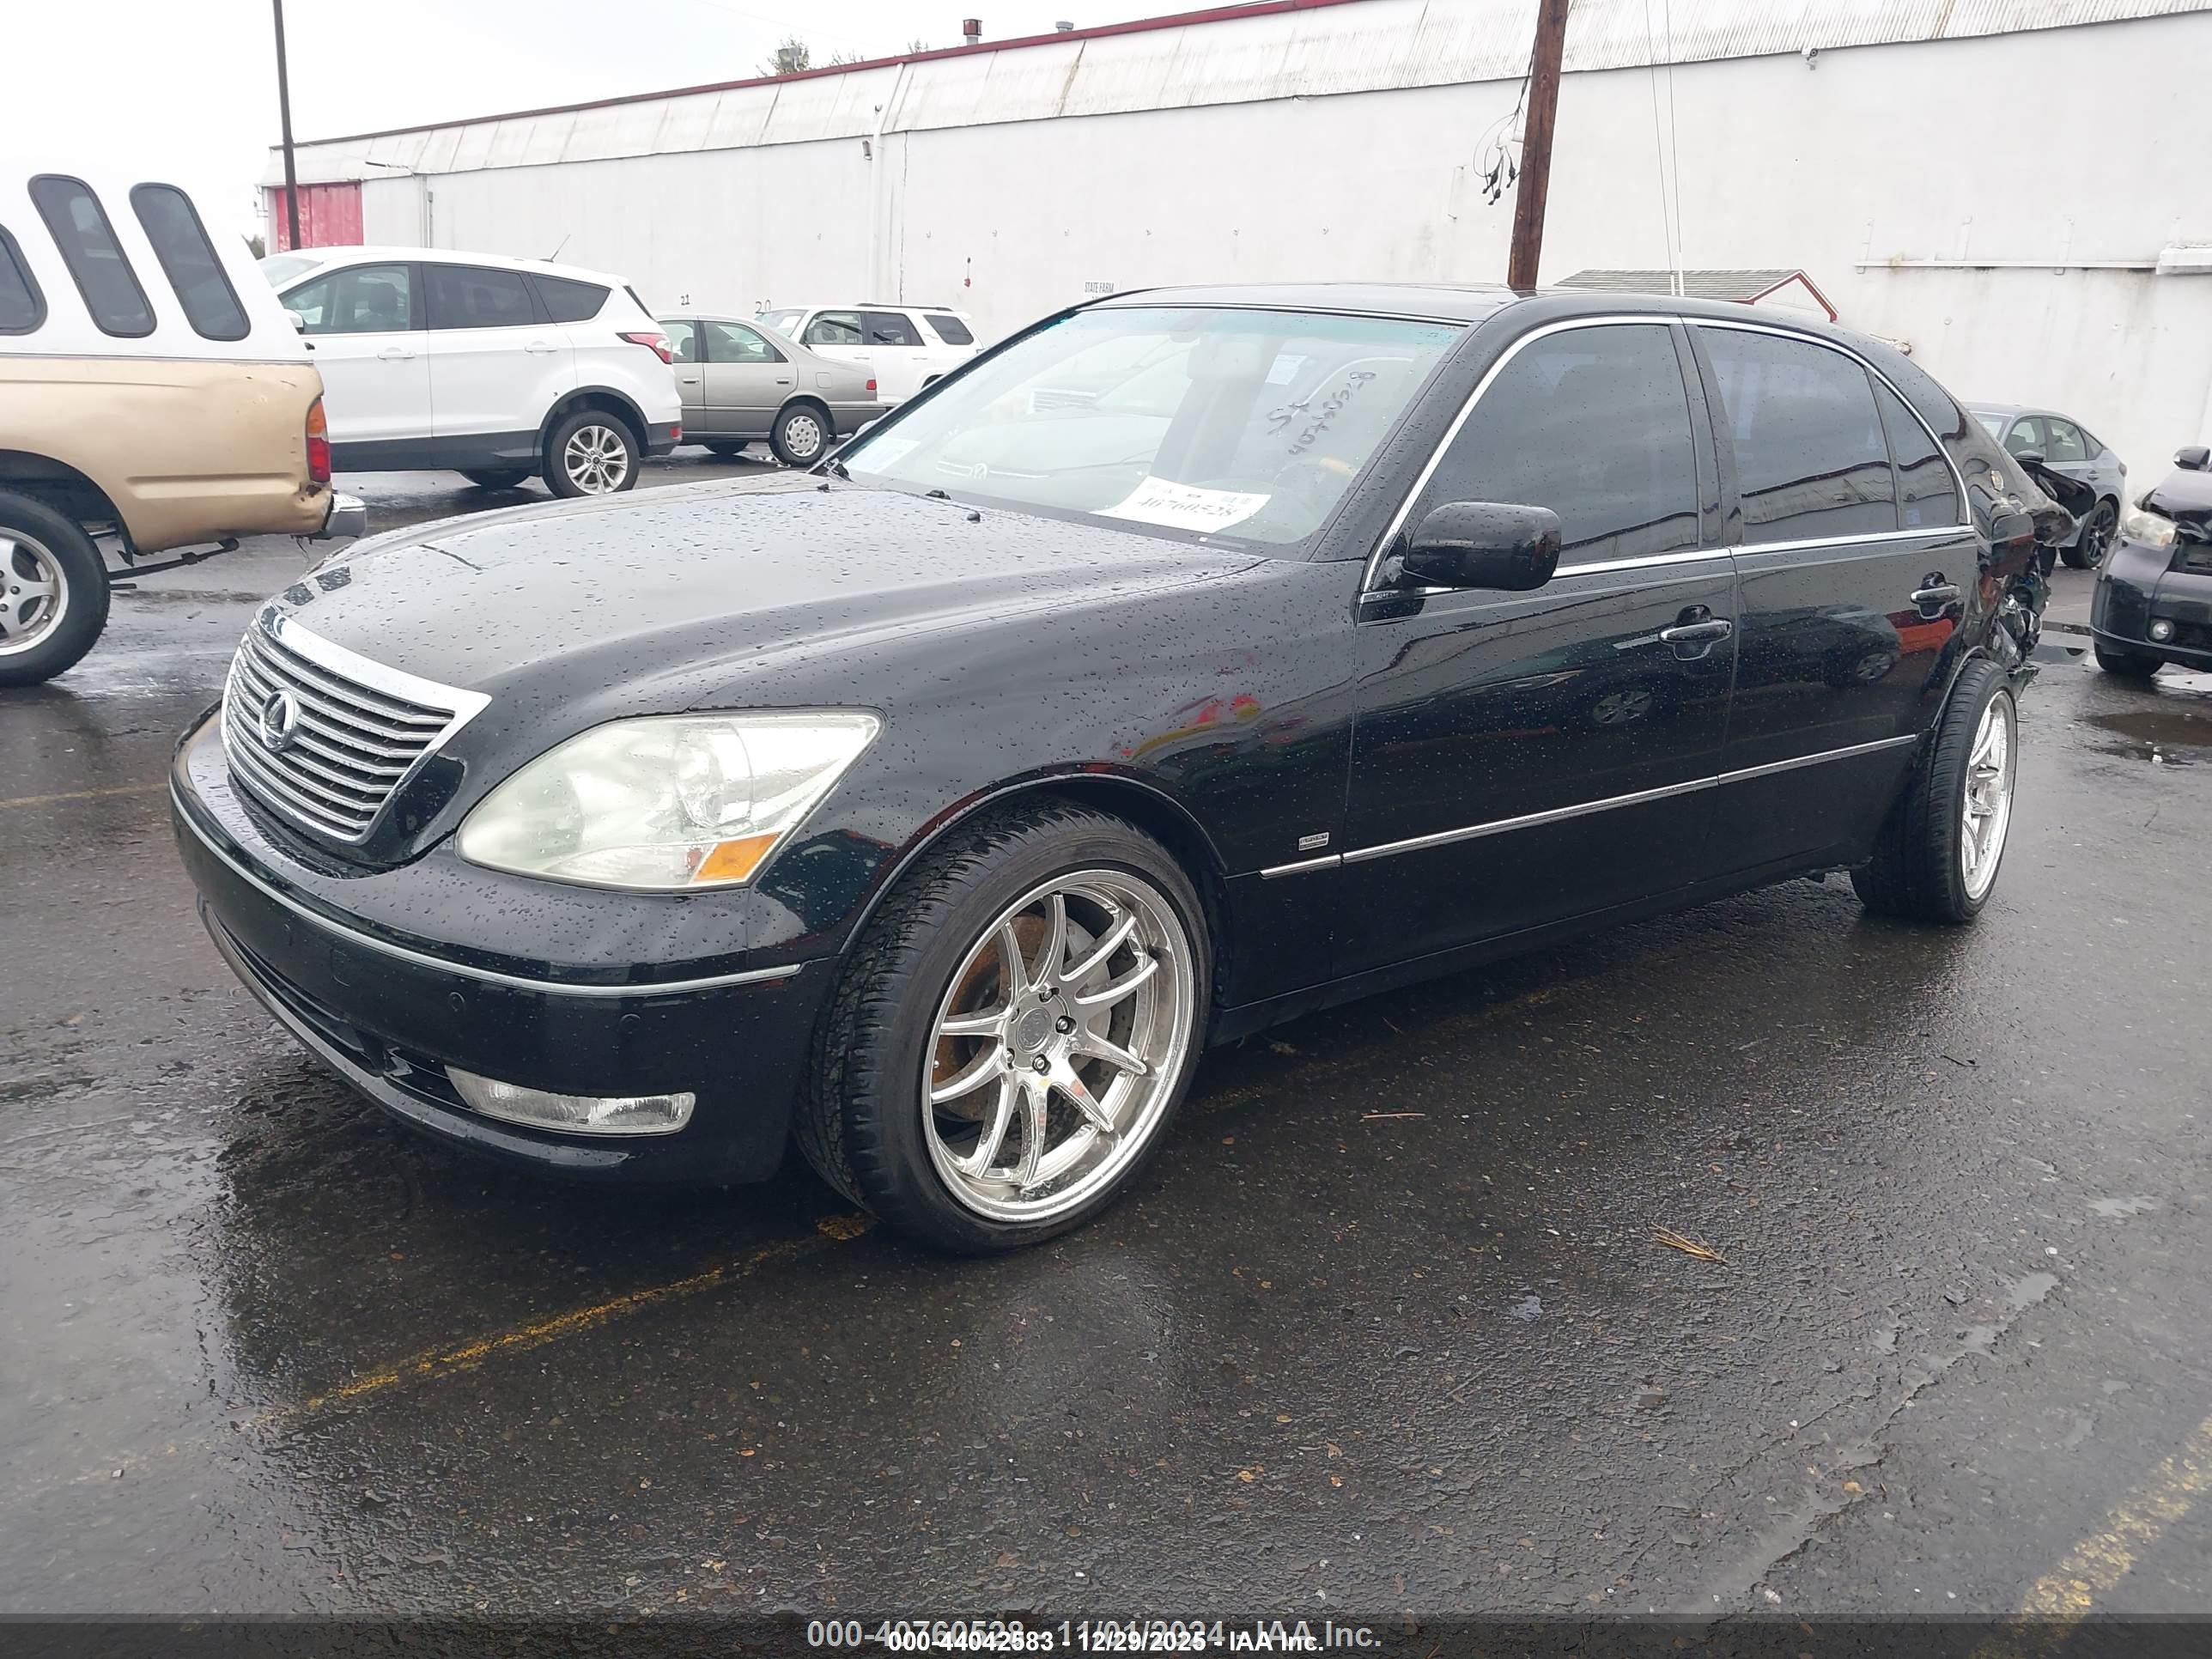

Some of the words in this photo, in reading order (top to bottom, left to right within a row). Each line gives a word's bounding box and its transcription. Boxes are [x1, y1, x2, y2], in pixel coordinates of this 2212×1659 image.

[1085, 281, 1100, 293] STATE
[1099, 282, 1114, 294] FARM
[680, 294, 690, 306] 21
[755, 299, 771, 314] 20
